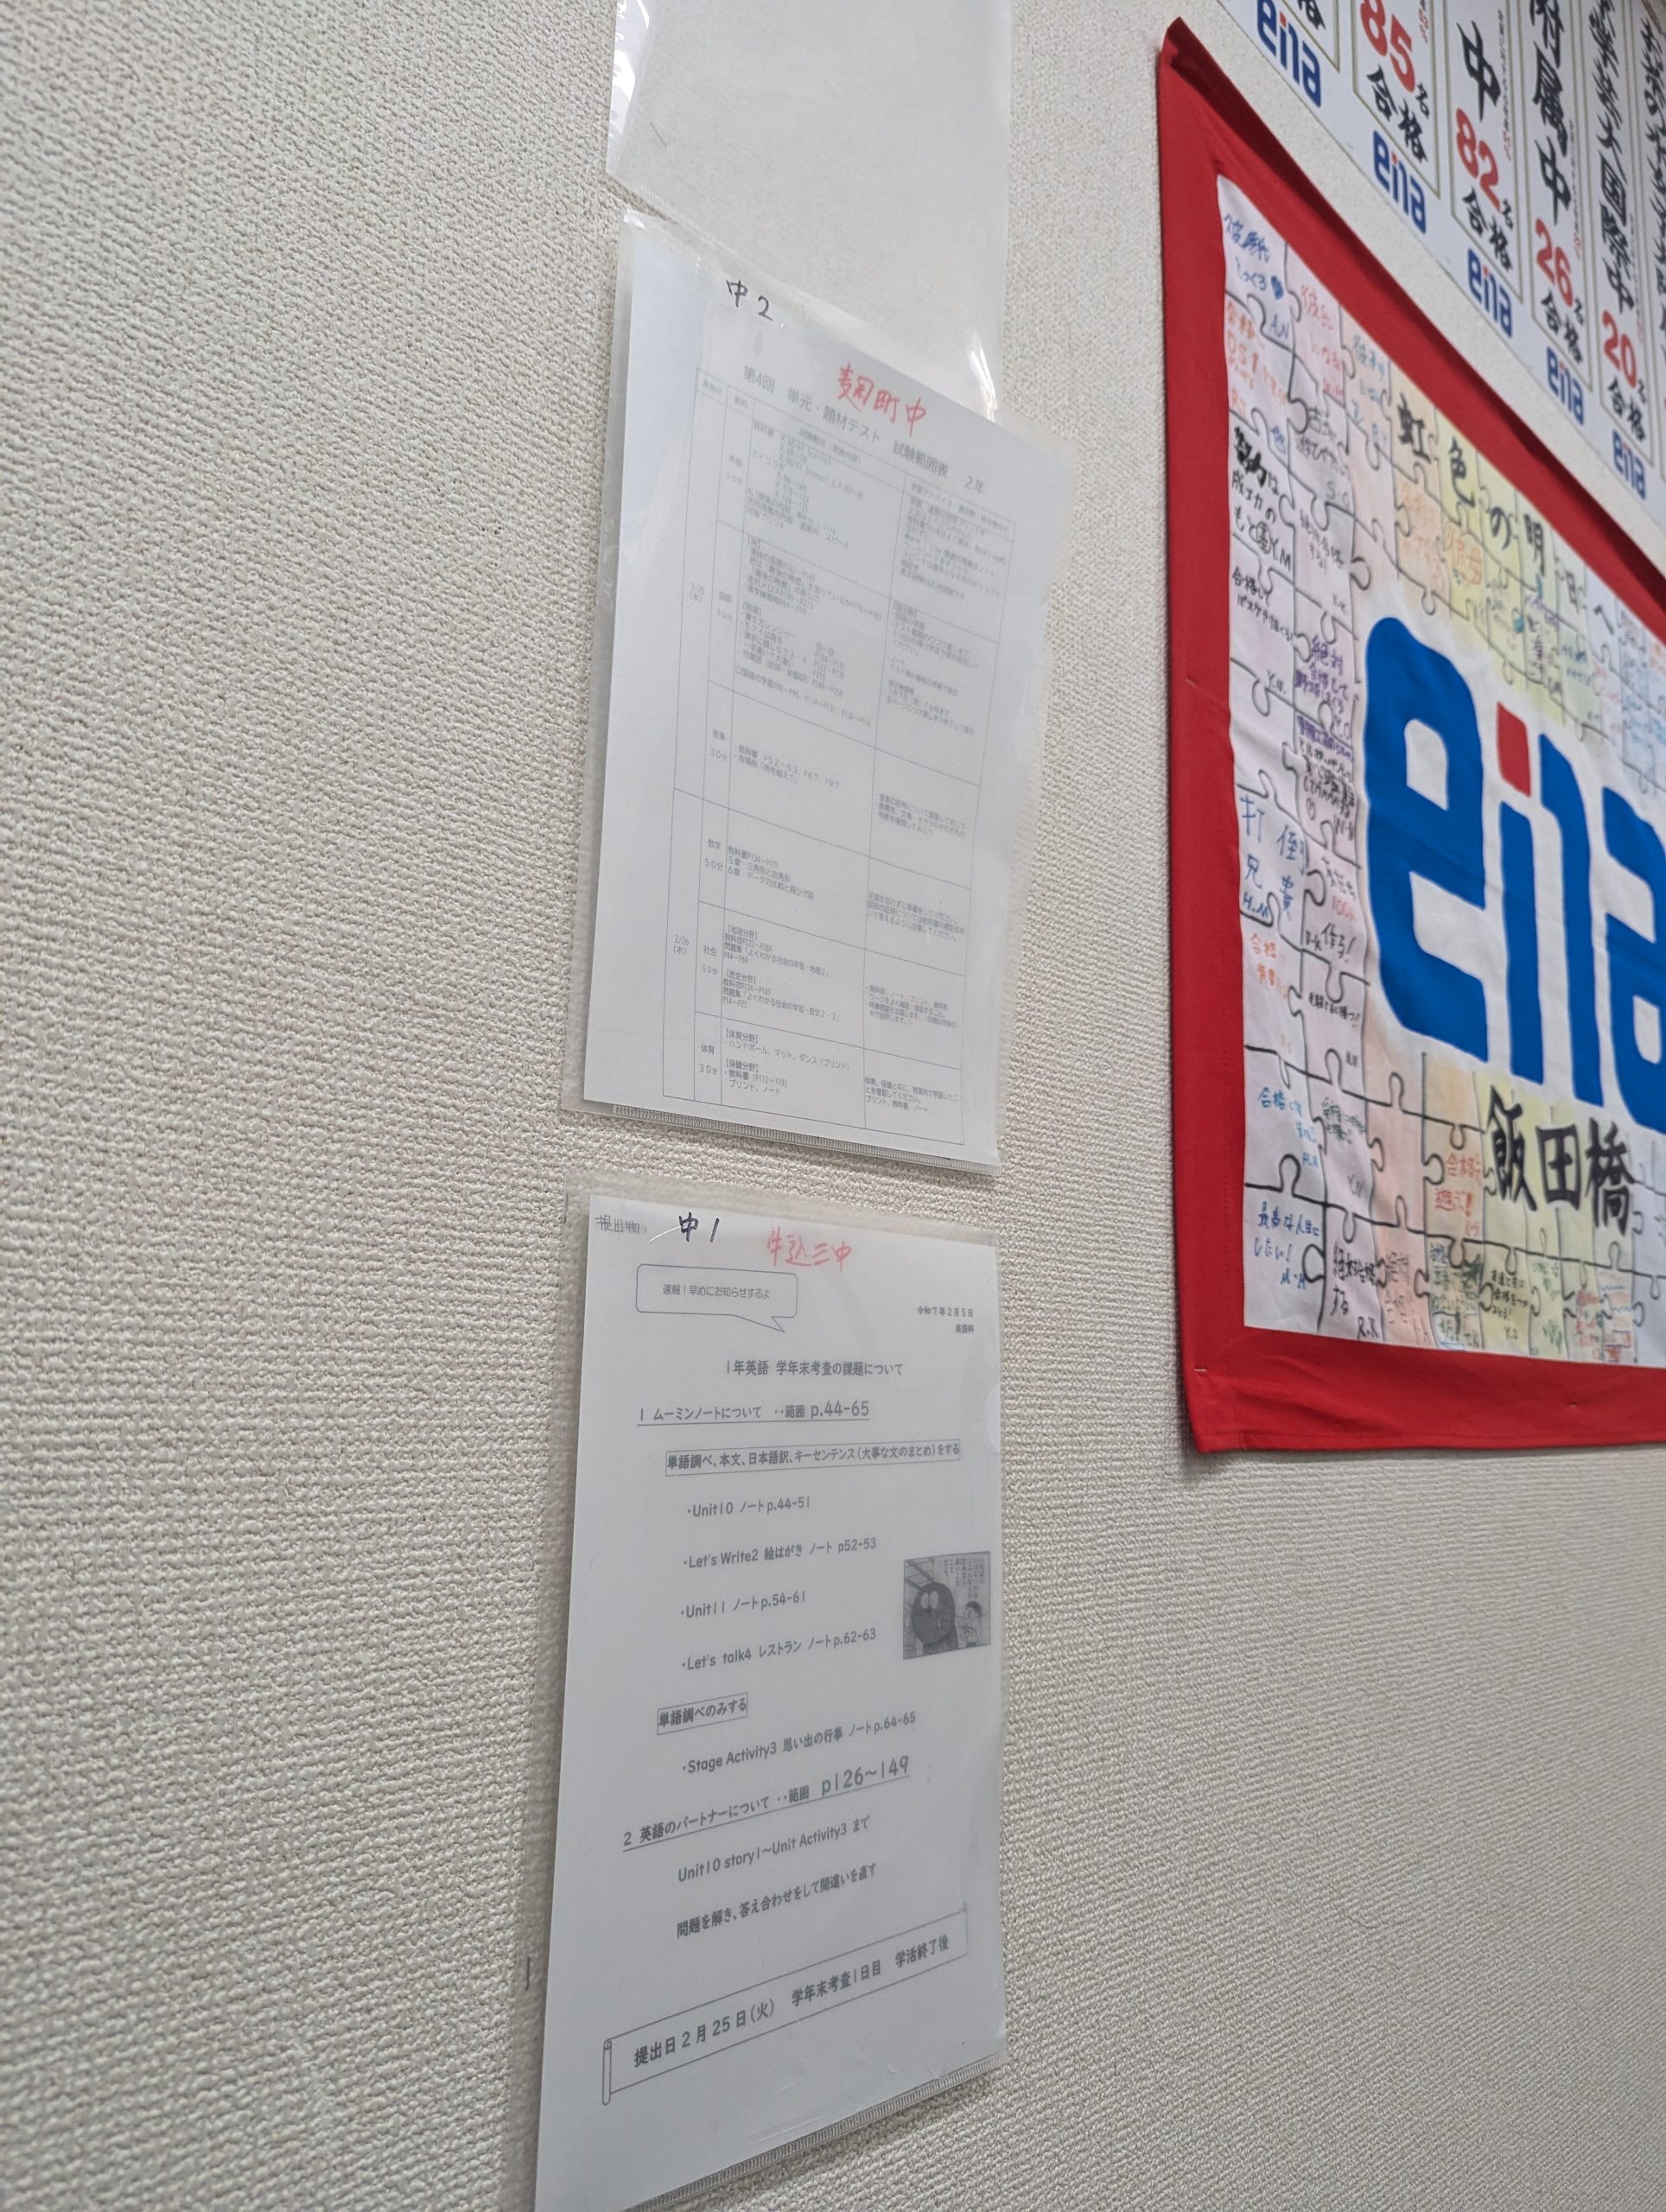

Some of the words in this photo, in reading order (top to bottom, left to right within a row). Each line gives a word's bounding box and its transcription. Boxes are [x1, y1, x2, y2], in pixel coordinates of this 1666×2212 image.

[1257, 0, 1321, 108] ena
[1456, 20, 1500, 122] 中
[1366, 65, 1428, 162] 合格
[1372, 130, 1426, 234] ena
[1462, 188, 1511, 273] 合格
[1467, 249, 1511, 338] ena
[1541, 289, 1582, 364] 合格
[1547, 346, 1583, 425] ena
[1608, 376, 1644, 442] 合格
[743, 364, 775, 394] 第4回
[787, 386, 880, 442] 単元・題材テスト
[891, 440, 948, 477] 試験範囲表
[963, 474, 984, 493] 2年
[1612, 429, 1645, 499] ena
[1364, 616, 1666, 1136] ena
[672, 944, 686, 955] (木)
[700, 1043, 715, 1055] 体育
[1489, 1084, 1637, 1236] 飯田橋
[1257, 1200, 1319, 1236] 最高な人生に
[662, 1283, 771, 1300] 速報!早めにお知らせするよ
[955, 1324, 975, 1334] 英語科
[726, 1360, 770, 1376] 1年英語
[776, 1361, 904, 1377] 学年末考査の課題について
[653, 1405, 761, 1421] ムーミンノートについて
[811, 1401, 869, 1420] p.44-65
[721, 1548, 759, 1565] Write2
[764, 1543, 803, 1561] 絵はがき
[809, 1541, 833, 1554] ノート
[838, 1537, 877, 1554] p52-53
[722, 1649, 752, 1664] talk4
[760, 1641, 802, 1660] レストラン
[658, 1696, 747, 1728] 単語調べのみする
[726, 1742, 778, 1766] Activity3
[783, 1726, 843, 1753] 思い出の行事
[624, 1832, 632, 1847] 2
[639, 1795, 770, 1843] 英語のパートナーについて
[822, 1756, 910, 1796] p126~149
[678, 1859, 721, 1882] Unit10
[799, 1823, 847, 1848] Activity3
[852, 1815, 871, 1834] まで
[677, 1862, 878, 1938] 問題を解き、答え合わせをして間違いを直す
[792, 1959, 882, 2007] 学年末考査1日目
[895, 1934, 950, 1968] 学活終了後
